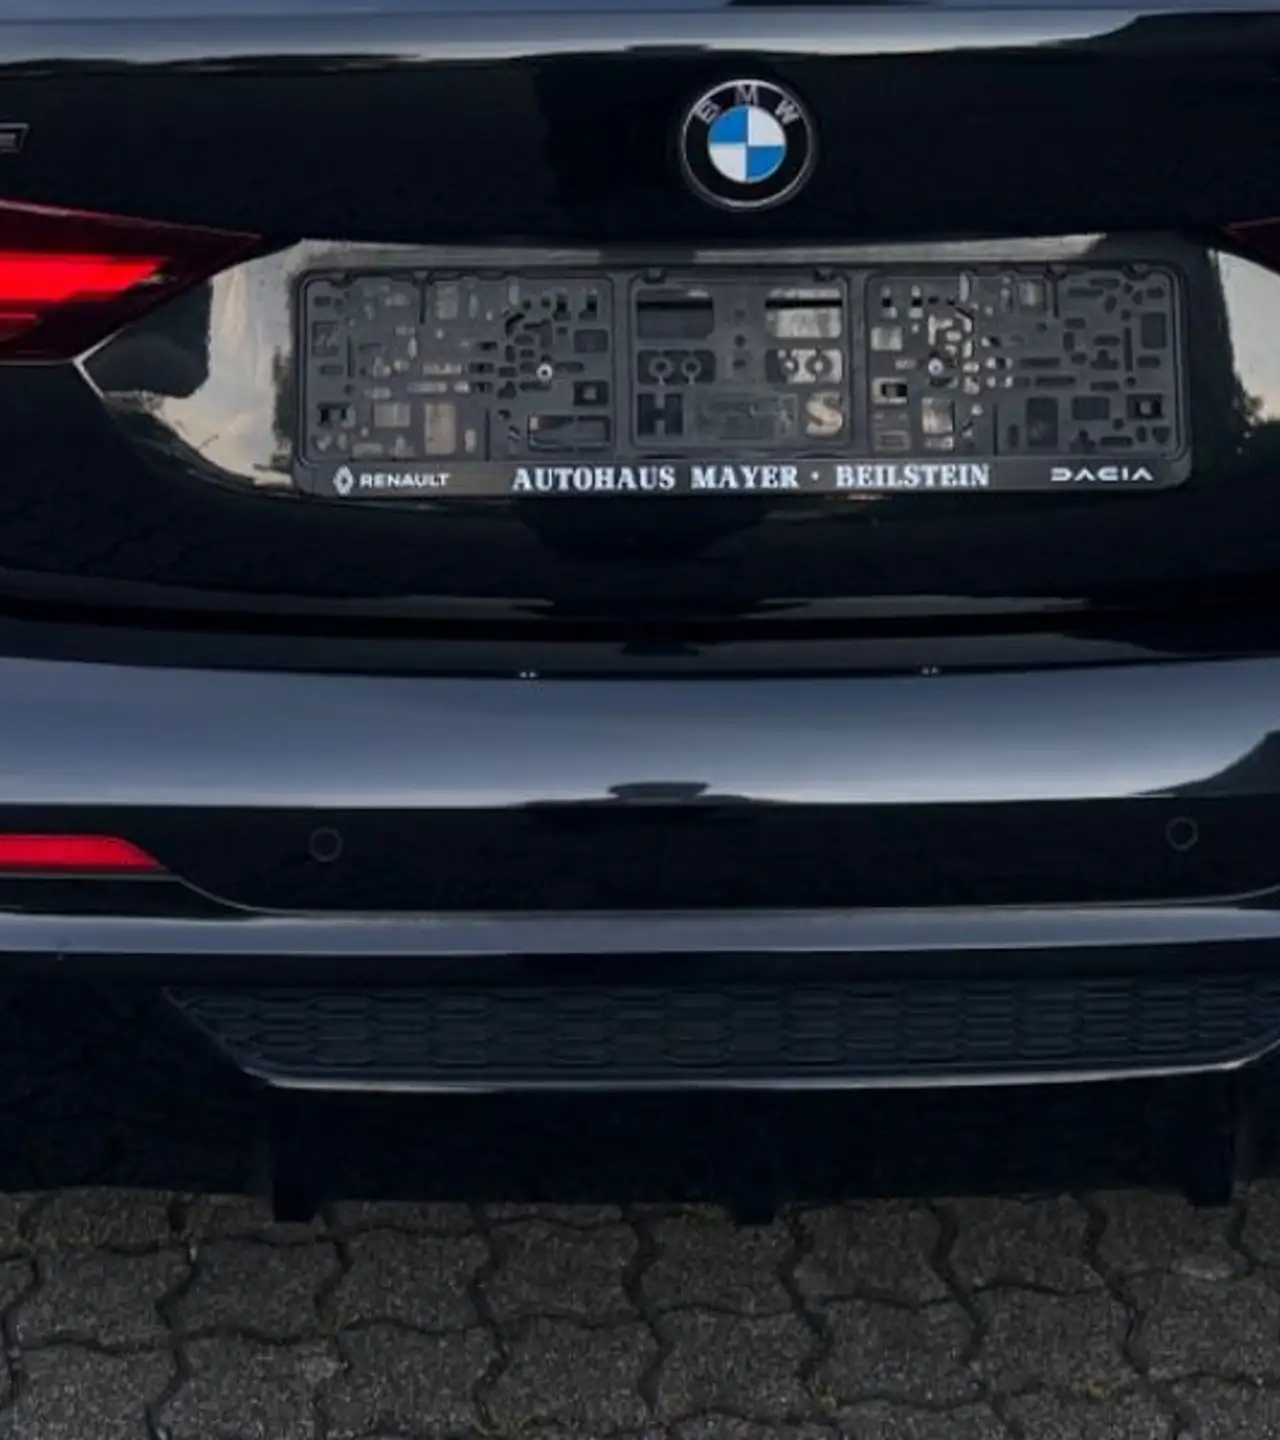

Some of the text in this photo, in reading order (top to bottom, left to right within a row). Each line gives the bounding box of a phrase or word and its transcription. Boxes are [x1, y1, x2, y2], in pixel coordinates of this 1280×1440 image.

[694, 83, 801, 125] BMW
[359, 472, 452, 489] RENAULT
[512, 463, 991, 492] AUTOHAUS MAYER BEILSTEIN
[1050, 467, 1154, 482] DACIA
